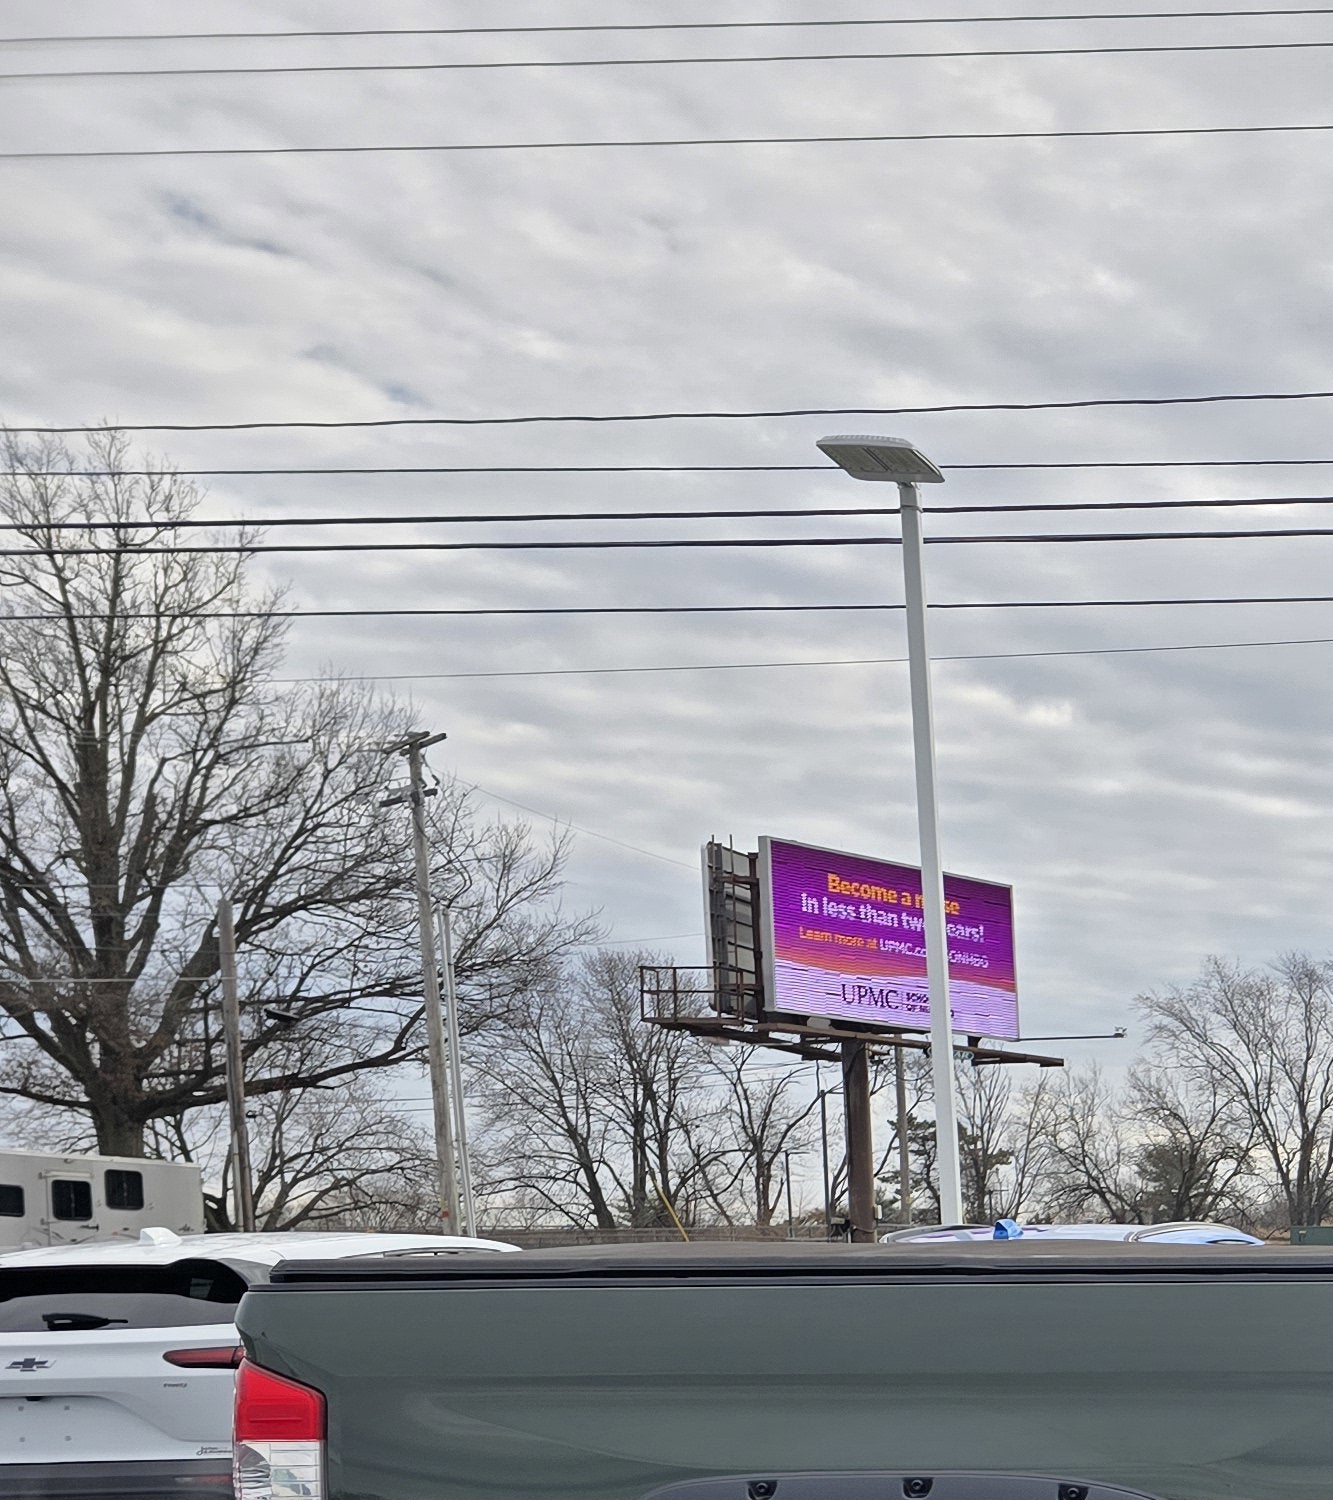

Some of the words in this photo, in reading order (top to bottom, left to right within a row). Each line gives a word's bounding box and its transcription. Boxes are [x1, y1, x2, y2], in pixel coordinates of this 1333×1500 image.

[827, 873, 898, 903] Become
[901, 891, 912, 906] a
[915, 893, 960, 915] nse
[822, 897, 856, 920] less
[858, 904, 899, 927] than
[901, 913, 926, 931] tw
[946, 922, 984, 943] ears!
[841, 984, 899, 1010] UPMC
